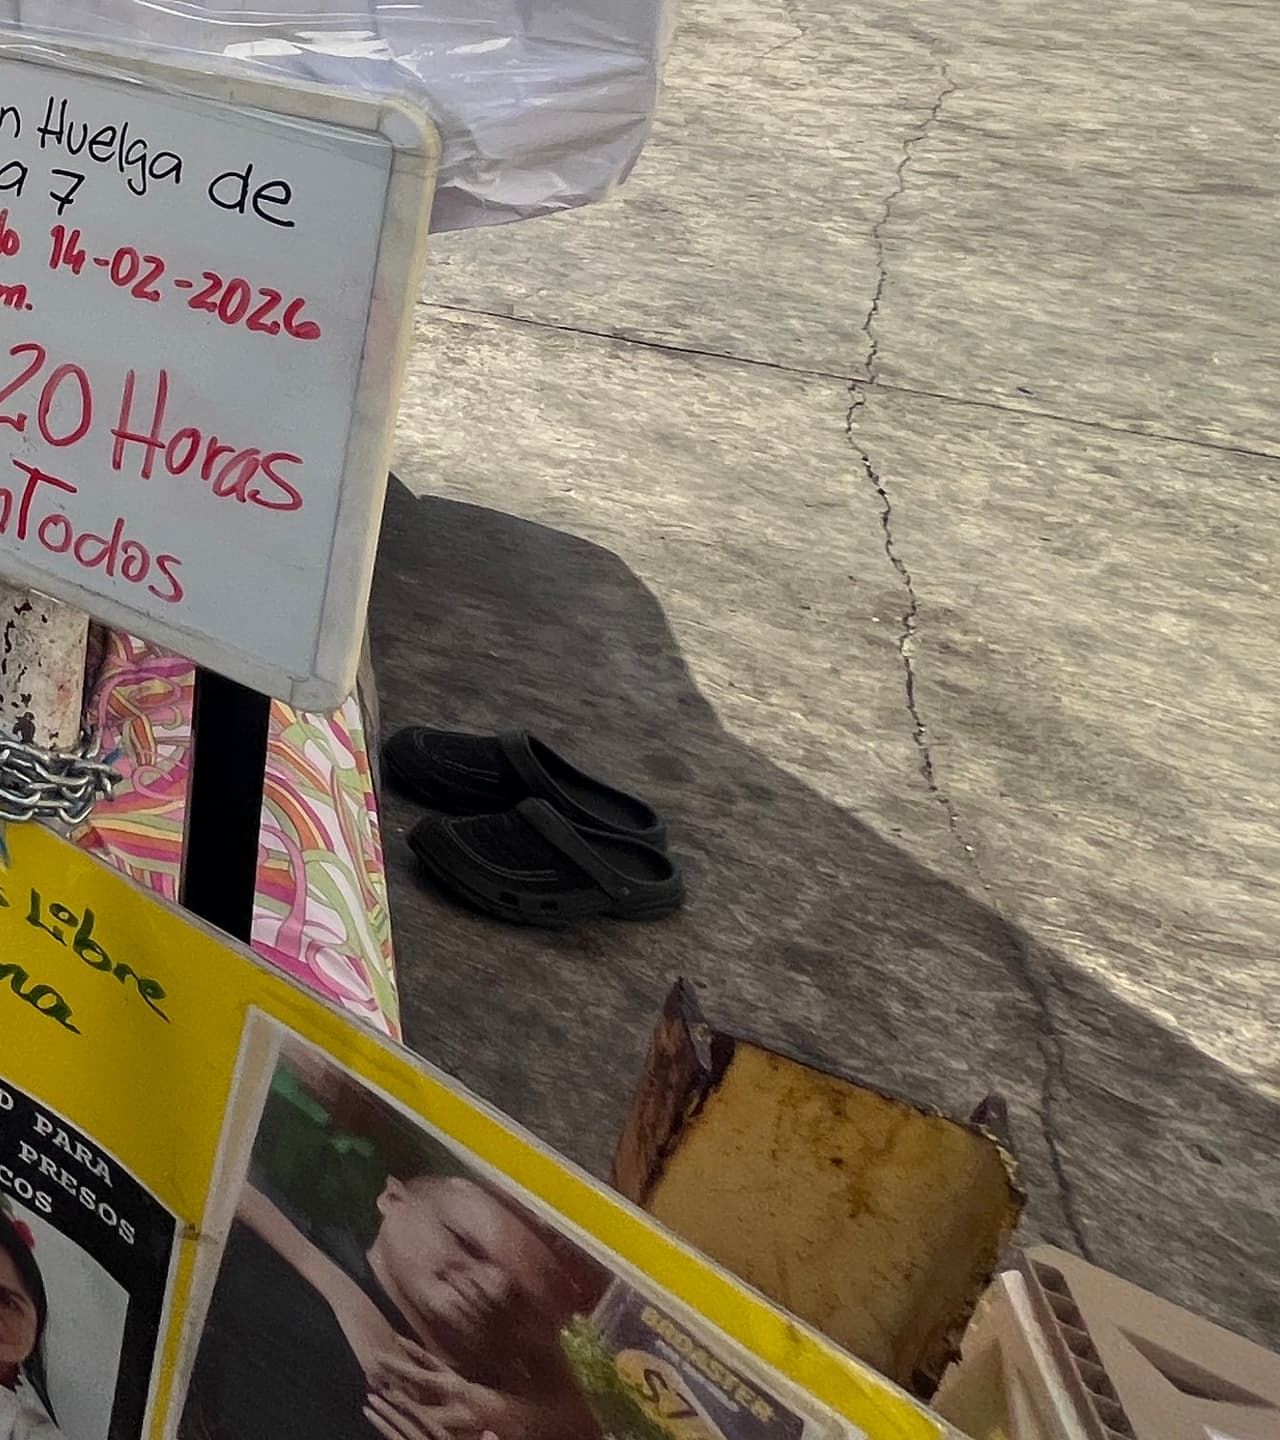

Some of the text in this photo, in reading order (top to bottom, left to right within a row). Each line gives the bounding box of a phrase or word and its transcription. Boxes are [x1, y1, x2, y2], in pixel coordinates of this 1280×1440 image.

[37, 97, 183, 198] Huelga
[208, 169, 297, 229] de
[49, 169, 86, 216] 7
[47, 224, 323, 341] 14-02-2026
[111, 366, 306, 513] Horas
[18, 1140, 136, 1245] PRESOS
[32, 1111, 113, 1188] PARA
